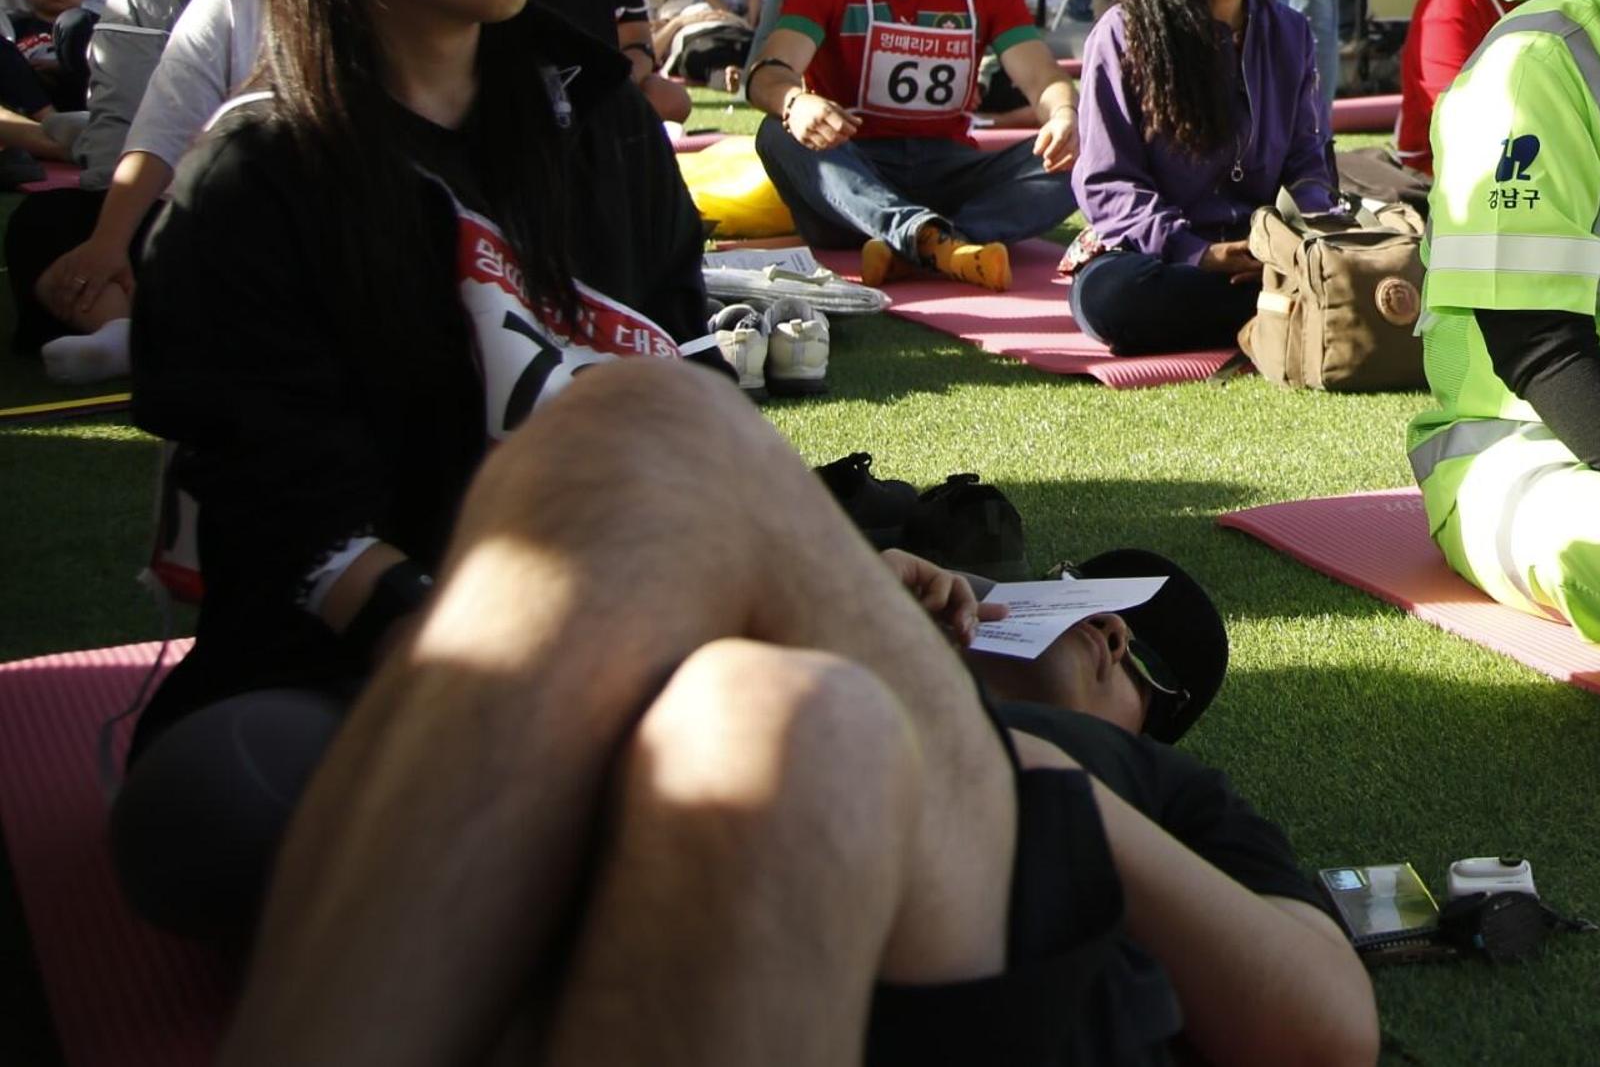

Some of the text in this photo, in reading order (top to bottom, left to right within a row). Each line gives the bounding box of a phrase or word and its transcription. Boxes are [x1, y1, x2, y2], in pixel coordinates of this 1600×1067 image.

[880, 33, 939, 53] 멍때리기
[888, 61, 955, 105] 68
[1488, 188, 1540, 210] 강남구
